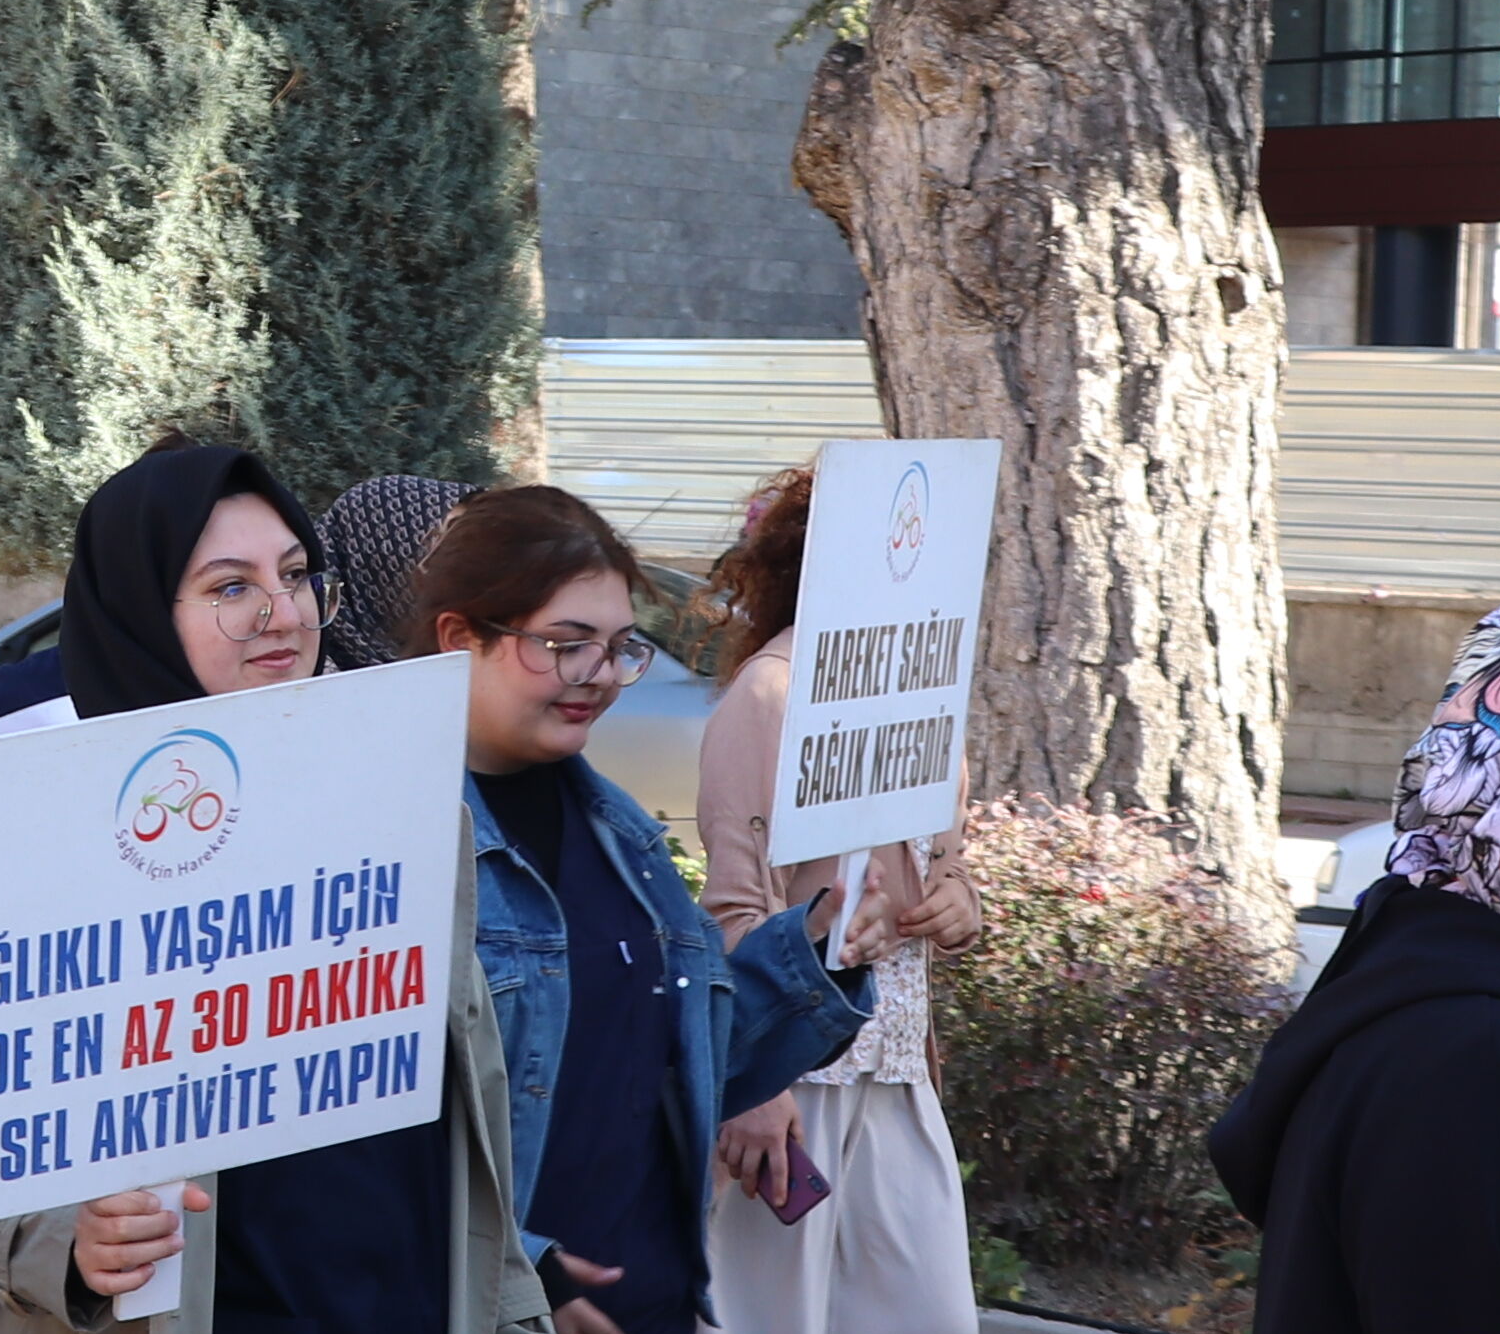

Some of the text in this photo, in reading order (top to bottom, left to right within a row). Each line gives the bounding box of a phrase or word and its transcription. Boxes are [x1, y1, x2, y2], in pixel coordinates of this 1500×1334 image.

[811, 609, 965, 706] HAREKET SAĞLIK
[796, 706, 954, 809] SAĞLIK NEFESDİR
[115, 829, 147, 872] Sağlık
[178, 827, 232, 875] Hareket
[142, 885, 294, 976] YAŞAM
[311, 857, 402, 945] İÇİN
[53, 1012, 105, 1084] EN
[120, 999, 175, 1070] AZ
[191, 983, 247, 1052] 30
[266, 945, 426, 1039] DAKİKA
[91, 1062, 276, 1163] AKTİVİTE
[294, 1031, 420, 1117] YAPIN
